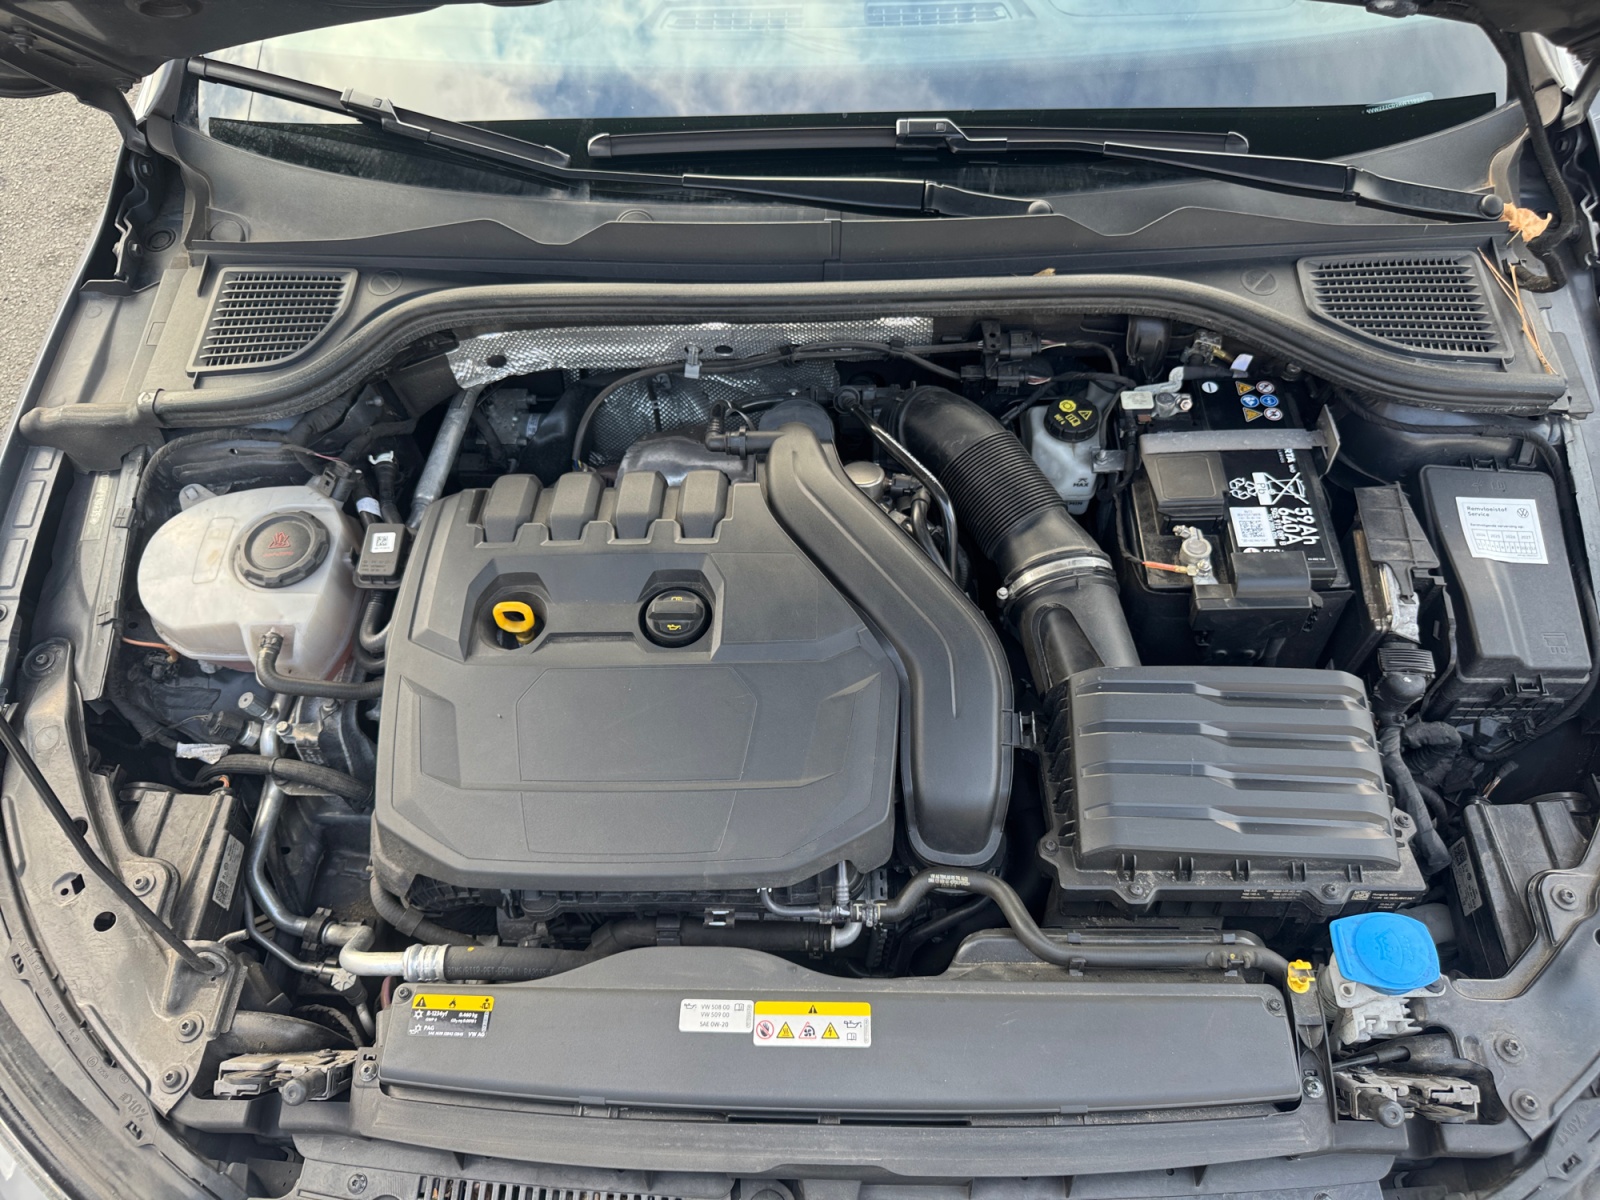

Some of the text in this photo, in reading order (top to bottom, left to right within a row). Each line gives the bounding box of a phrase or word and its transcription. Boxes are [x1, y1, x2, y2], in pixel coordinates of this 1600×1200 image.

[1284, 448, 1296, 463] RTA
[1257, 482, 1266, 495] Pb
[1278, 507, 1303, 545] 640A
[1294, 507, 1320, 545] 59Ah
